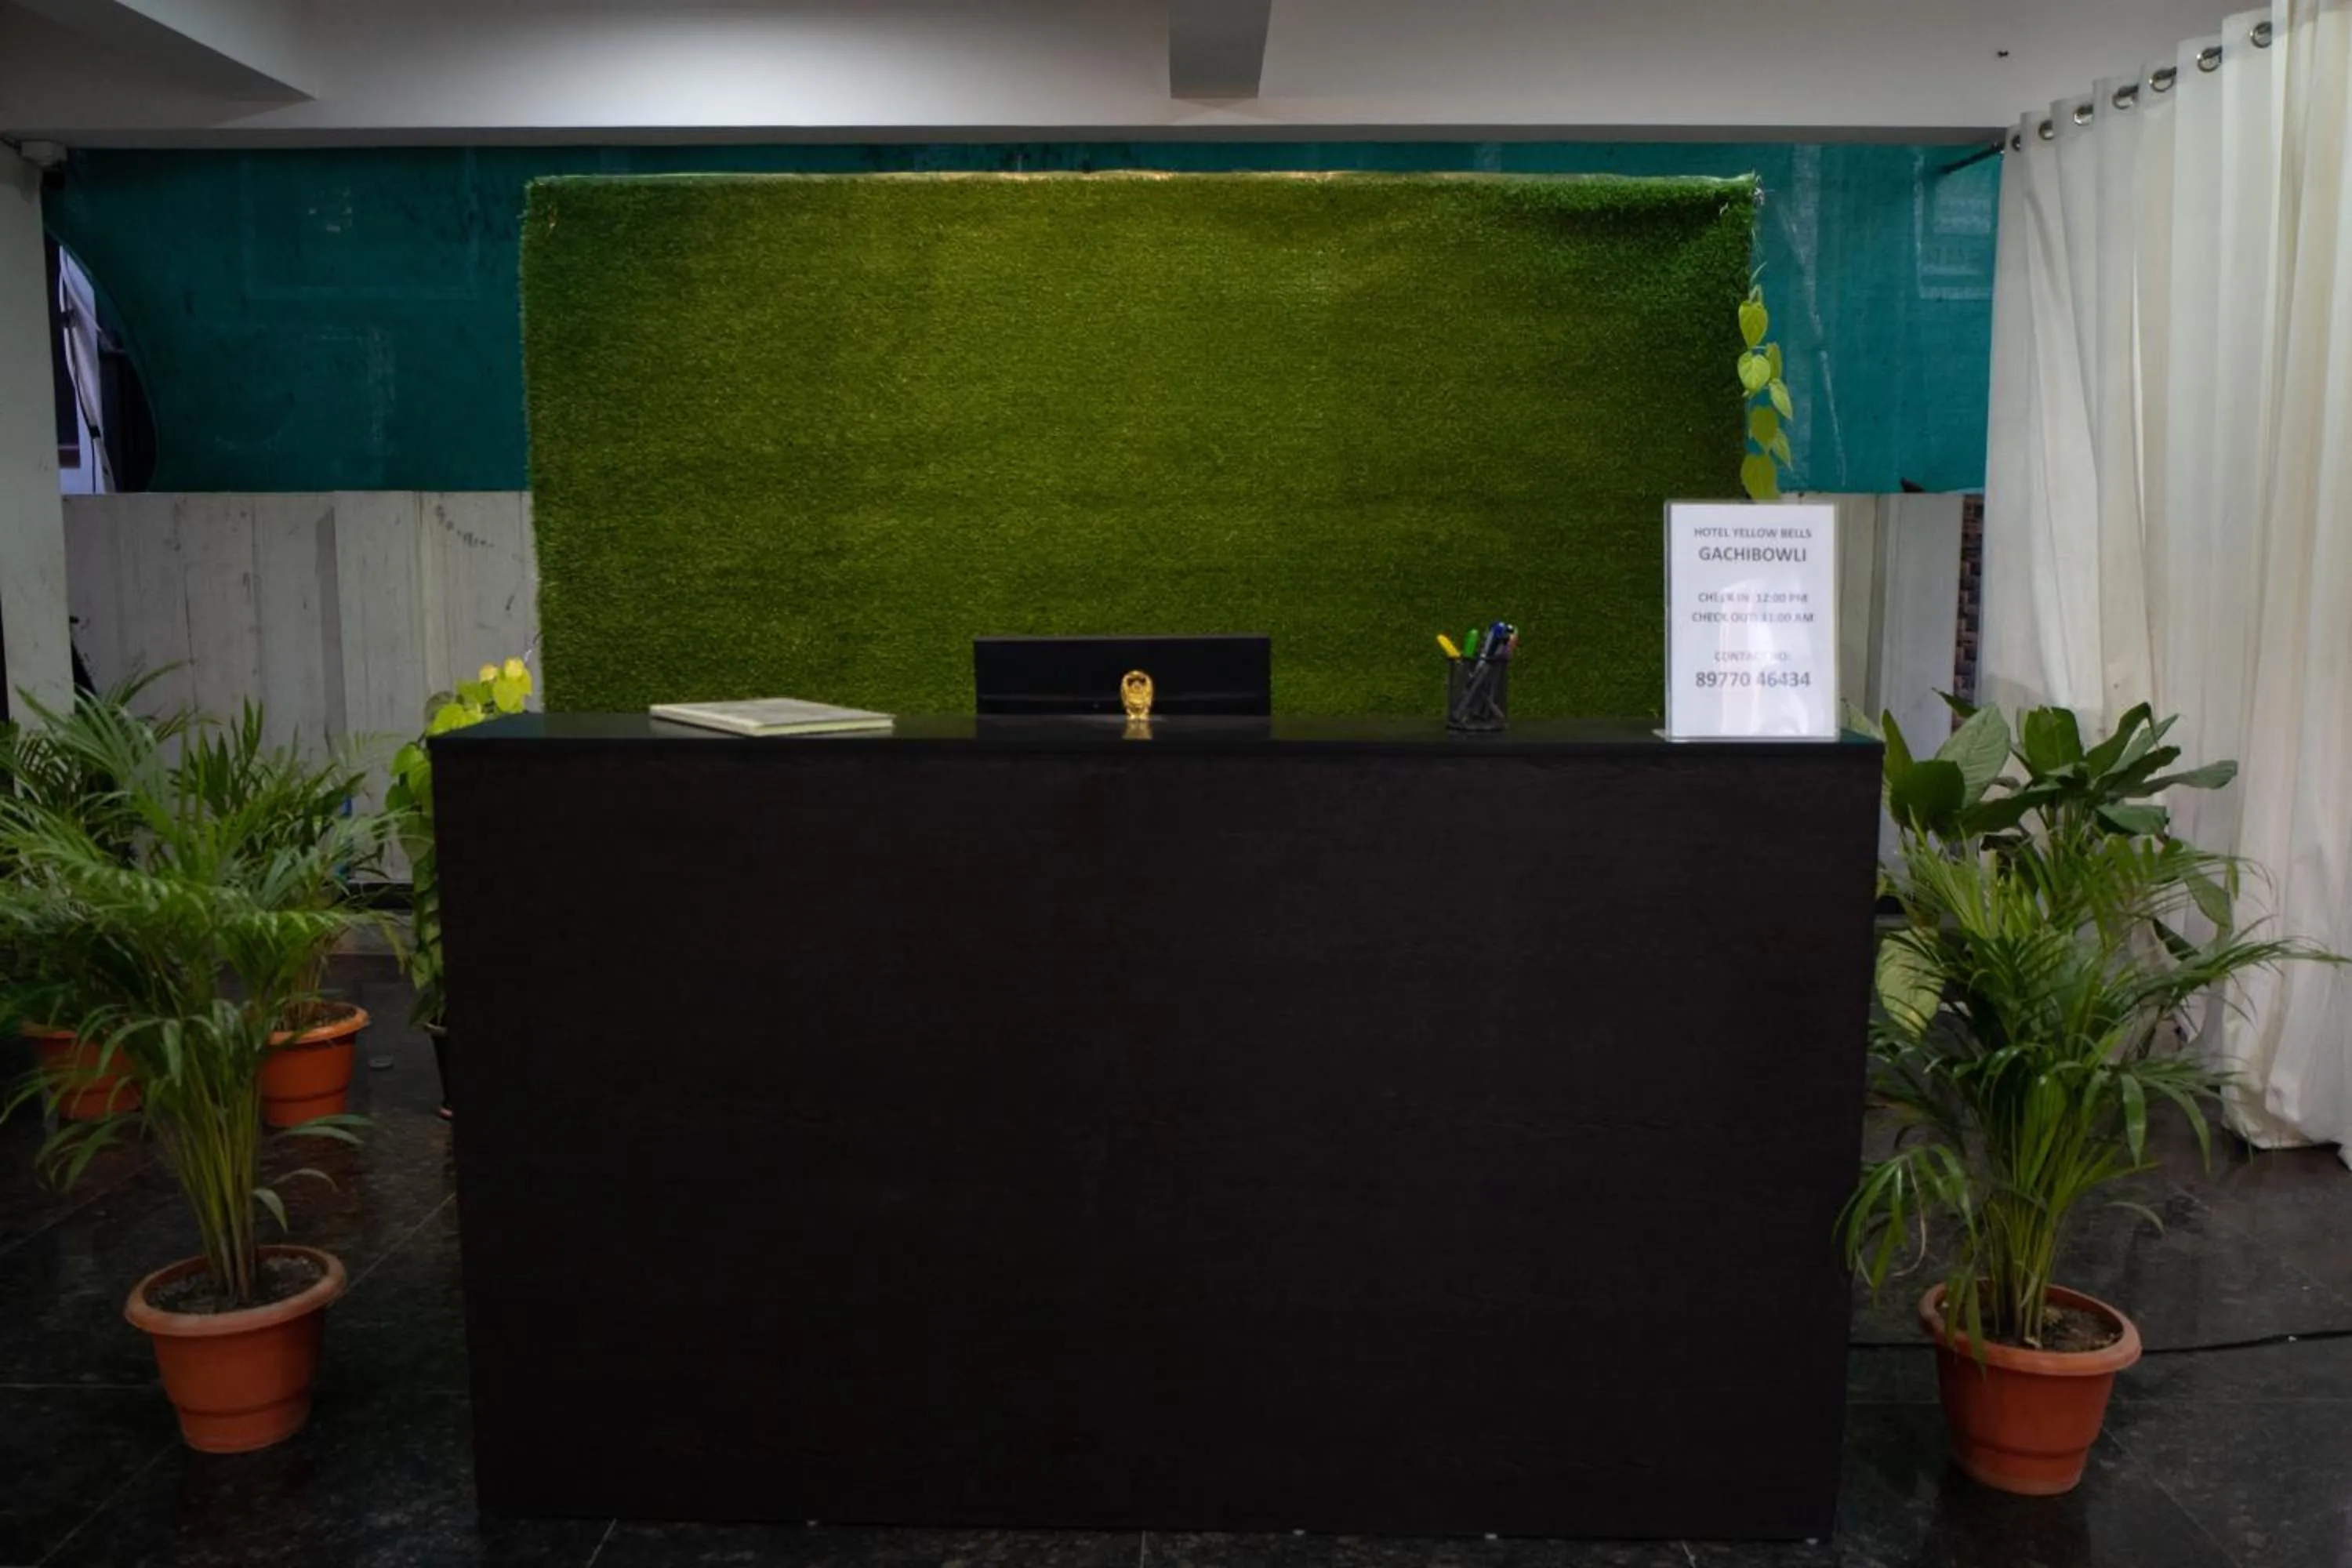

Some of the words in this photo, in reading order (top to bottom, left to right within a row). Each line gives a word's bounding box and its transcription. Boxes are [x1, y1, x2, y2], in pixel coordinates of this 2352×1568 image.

[1693, 527, 1730, 539] HOTEL
[1733, 528, 1777, 539] YELLOW
[1698, 546, 1807, 562] GACHIBOWLI
[1695, 671, 1751, 688] 89770
[1757, 671, 1811, 688] 46434
